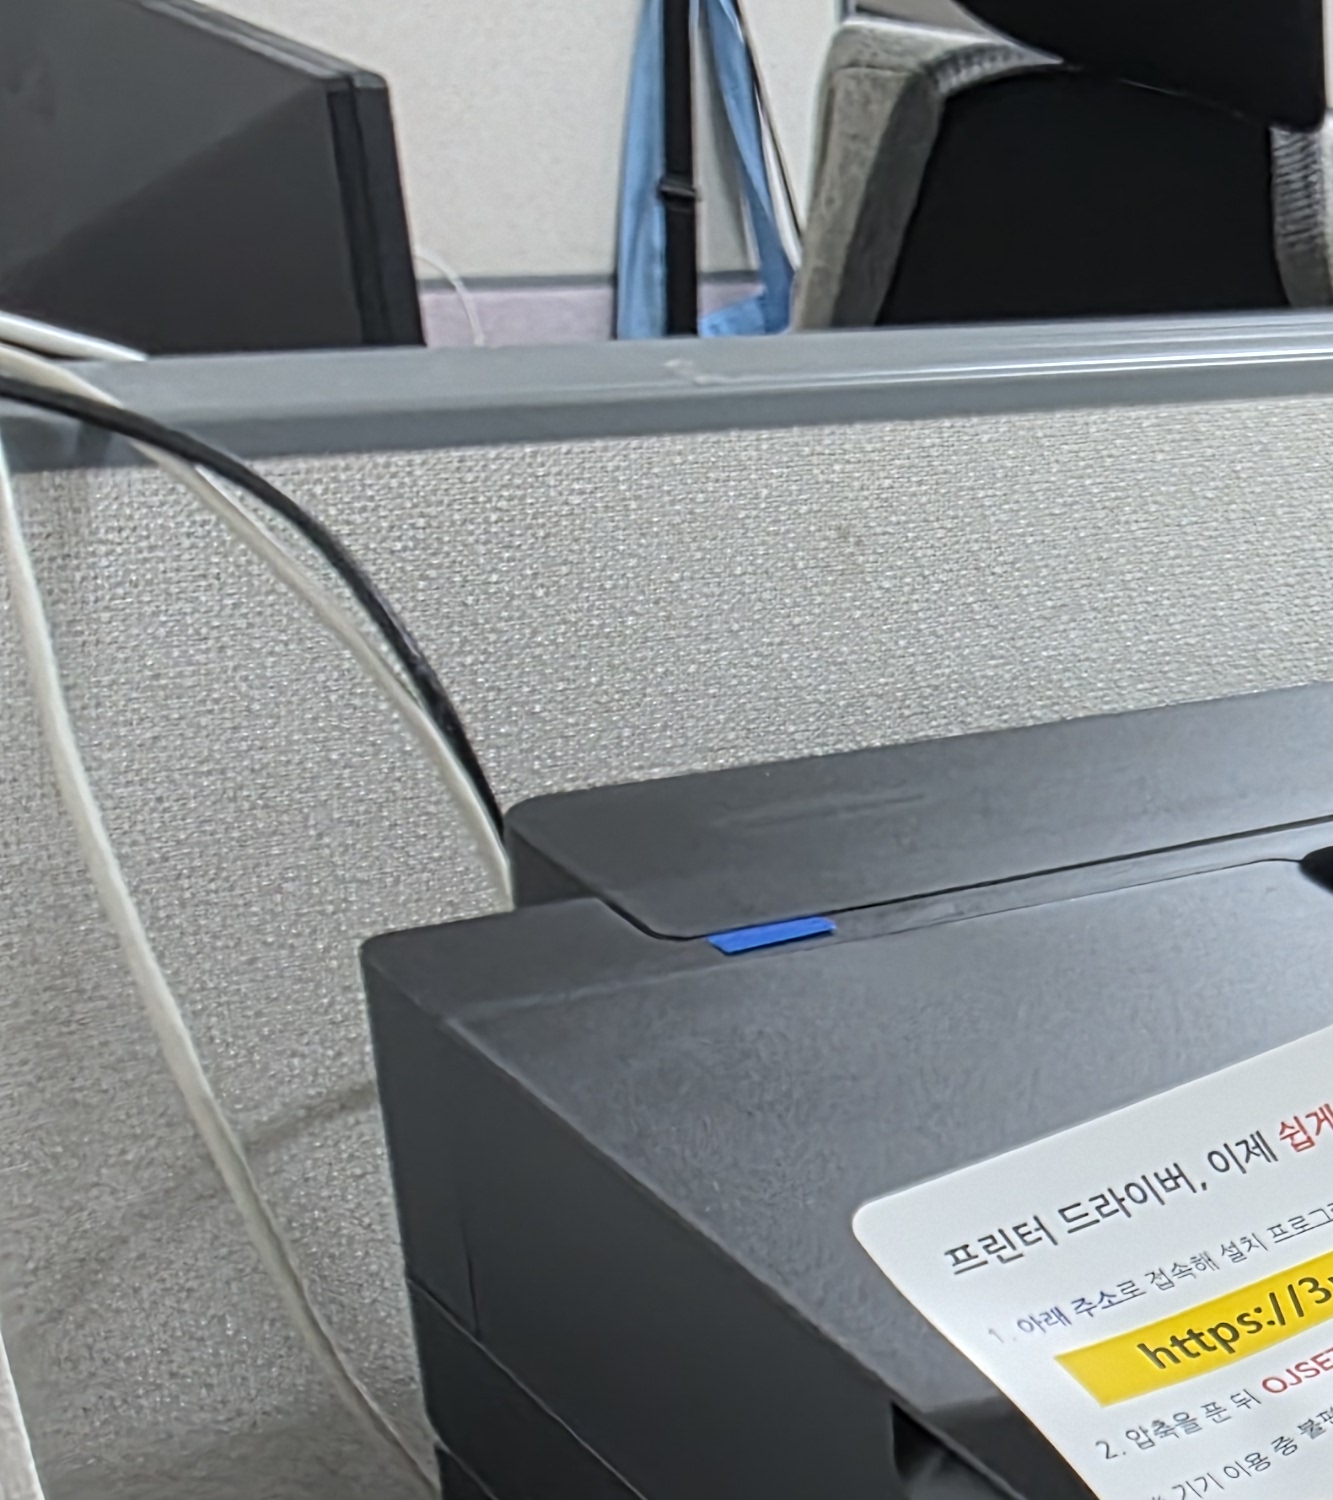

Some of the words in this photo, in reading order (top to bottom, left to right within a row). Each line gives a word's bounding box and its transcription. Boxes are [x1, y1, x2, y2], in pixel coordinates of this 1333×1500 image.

[944, 1214, 1058, 1275] 프린터
[1058, 1163, 1207, 1234] 드라이버,
[1207, 1130, 1279, 1174] 이제
[1016, 1306, 1073, 1334] 아래
[1071, 1280, 1147, 1318] 주소로
[1145, 1250, 1220, 1291] 접속해
[1220, 1232, 1269, 1263] 설치
[1095, 1439, 1126, 1460] 2.
[1125, 1410, 1204, 1451] 압축을
[1200, 1400, 1233, 1424] 푼
[1230, 1388, 1262, 1410] 뒤
[1222, 1452, 1272, 1480] 이용
[1270, 1435, 1299, 1458] 중
